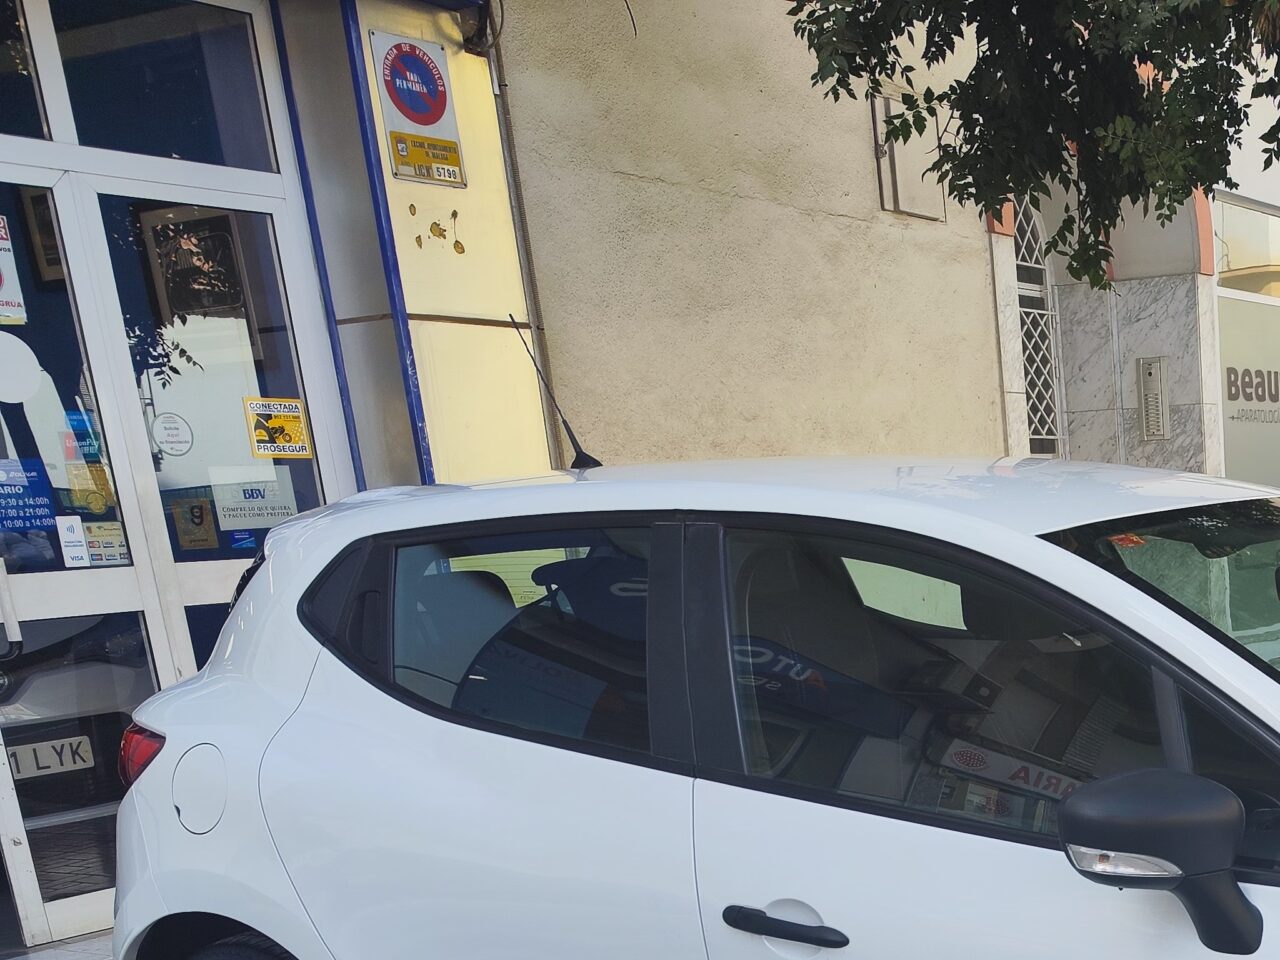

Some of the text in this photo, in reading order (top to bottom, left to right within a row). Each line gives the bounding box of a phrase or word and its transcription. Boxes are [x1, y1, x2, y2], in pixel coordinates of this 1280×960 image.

[383, 43, 445, 92] ENTRADA DE VEHICULOS
[436, 167, 457, 179] 5798
[249, 402, 300, 411] CONECTADA
[257, 444, 308, 453] PROSEGUR
[24, 496, 50, 505] 14:00h
[0, 509, 17, 518] 7:00
[25, 507, 50, 516] 21:00h
[33, 741, 87, 771] LYK
